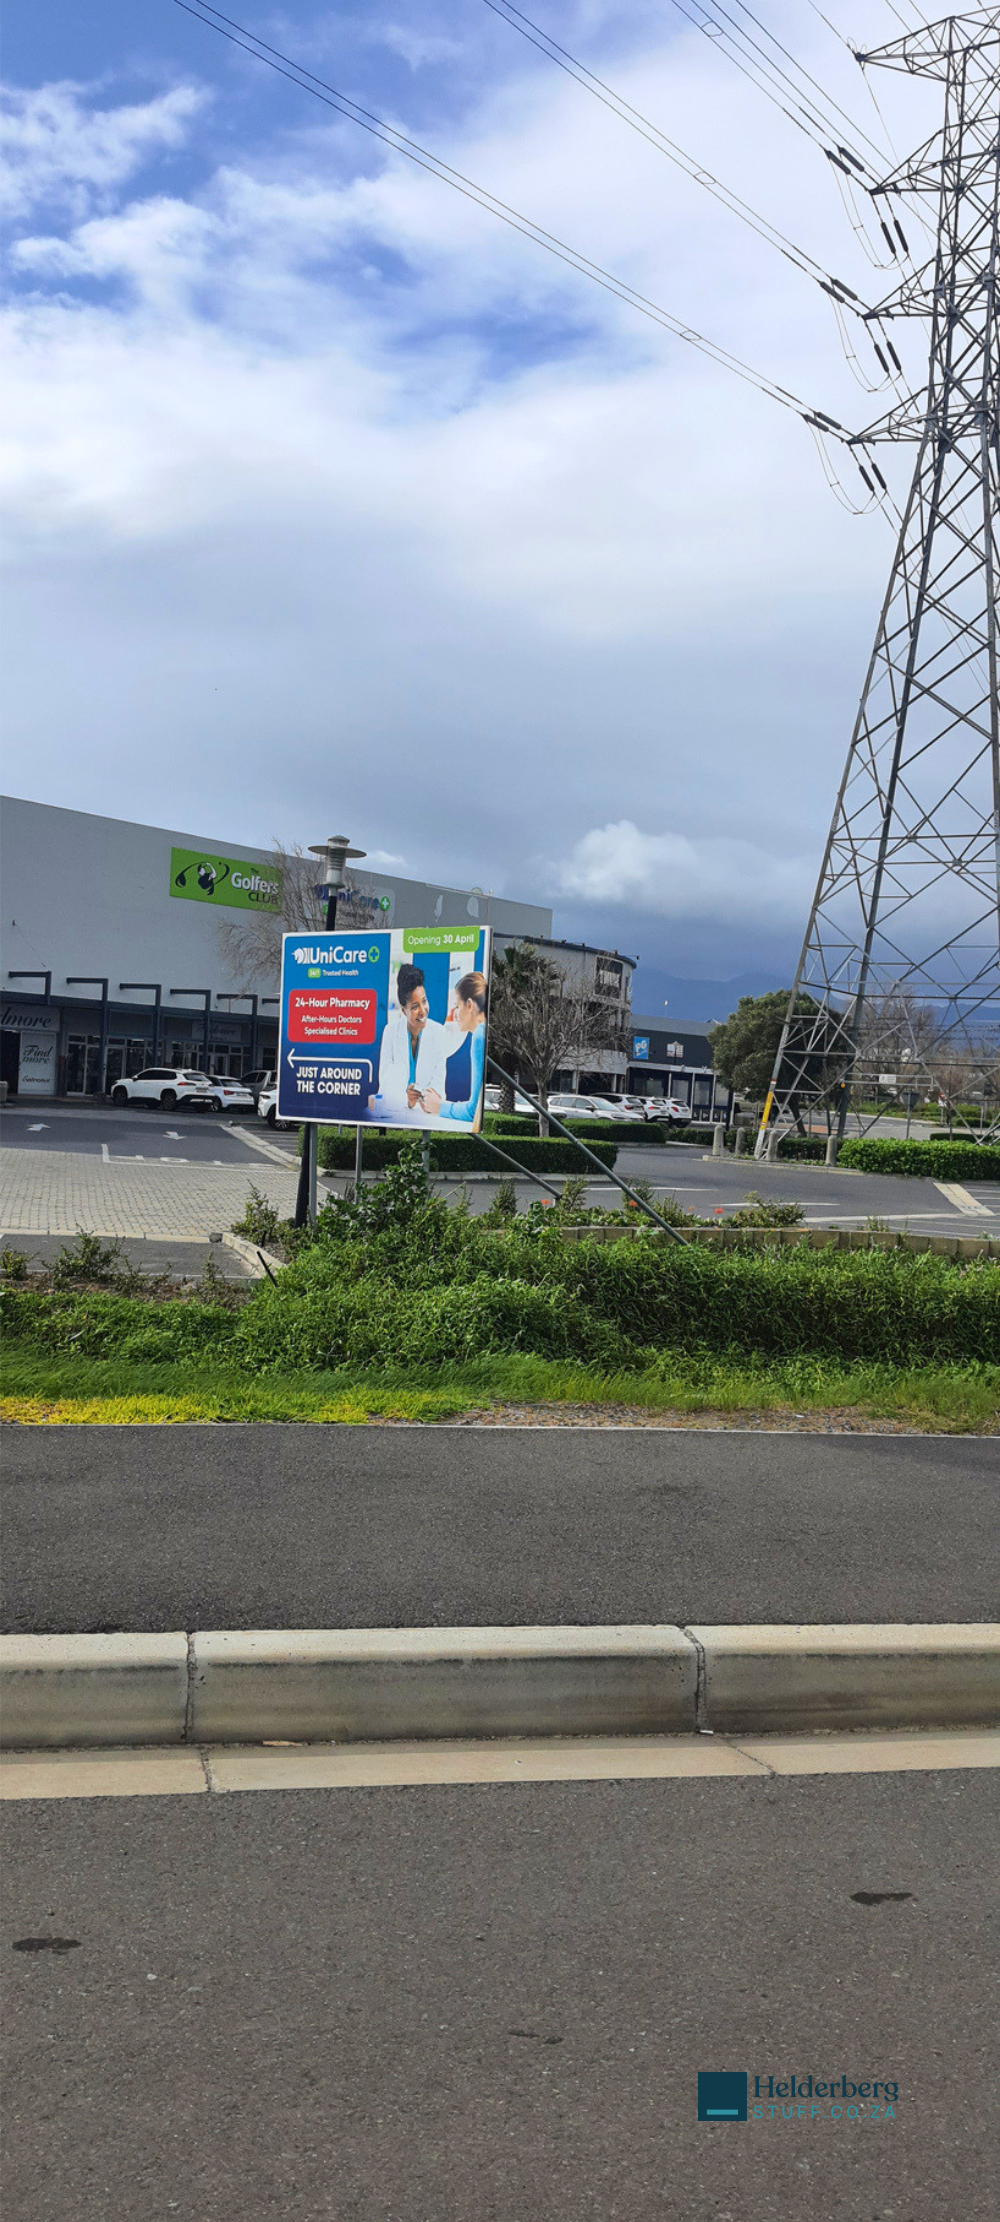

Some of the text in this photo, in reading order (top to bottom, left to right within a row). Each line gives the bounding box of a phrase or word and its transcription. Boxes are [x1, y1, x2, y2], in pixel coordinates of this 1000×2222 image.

[231, 871, 279, 895] Golfers
[407, 934, 475, 947] Opening 30 April
[310, 945, 367, 964] UniCare
[322, 969, 341, 977] Trusted
[295, 997, 370, 1010] 24-Hour Pharmacy
[301, 1015, 362, 1024] After-Hours Doctors
[304, 1027, 358, 1036] Specialised Clinics
[22, 1045, 54, 1058] Find
[22, 1056, 51, 1064] more
[296, 1066, 363, 1080] JUST AROUND
[296, 1080, 361, 1096] THE CORNER
